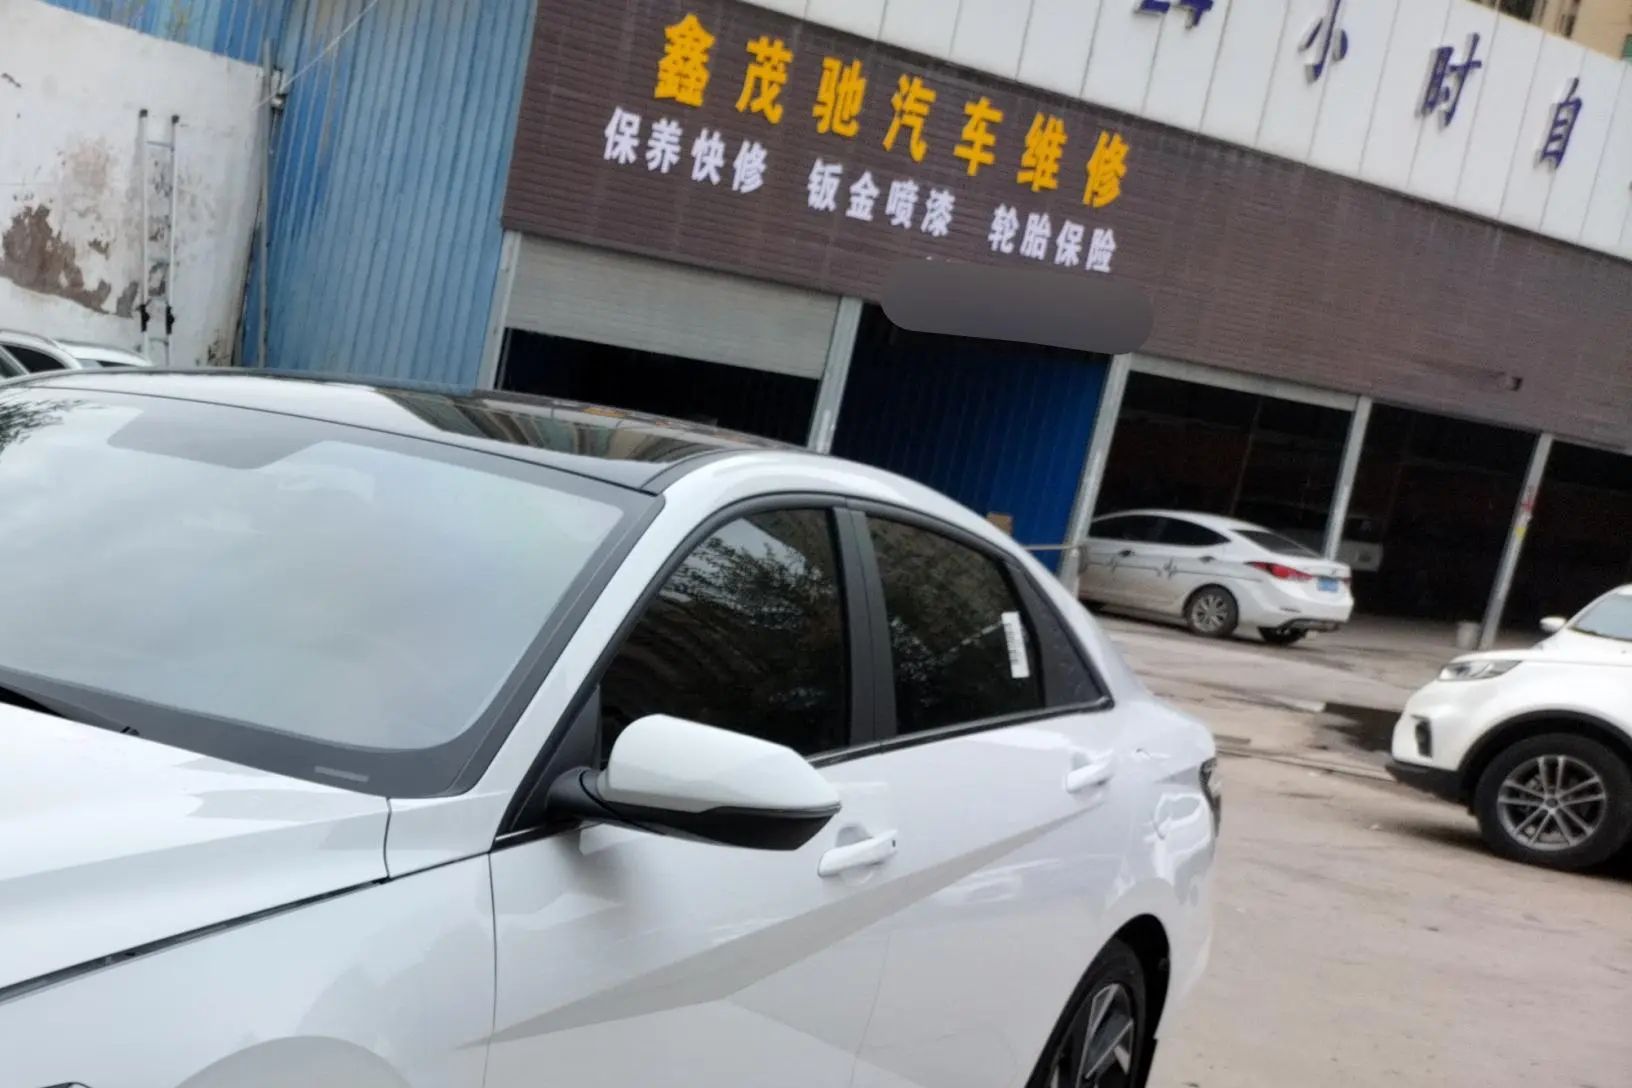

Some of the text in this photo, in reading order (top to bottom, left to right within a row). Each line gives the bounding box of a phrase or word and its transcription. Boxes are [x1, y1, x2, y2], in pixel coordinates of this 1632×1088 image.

[604, 107, 1117, 273] 保养快修 钣金喷漆 轮胎保险
[654, 13, 1130, 208] 鑫茂驰汽车维修
